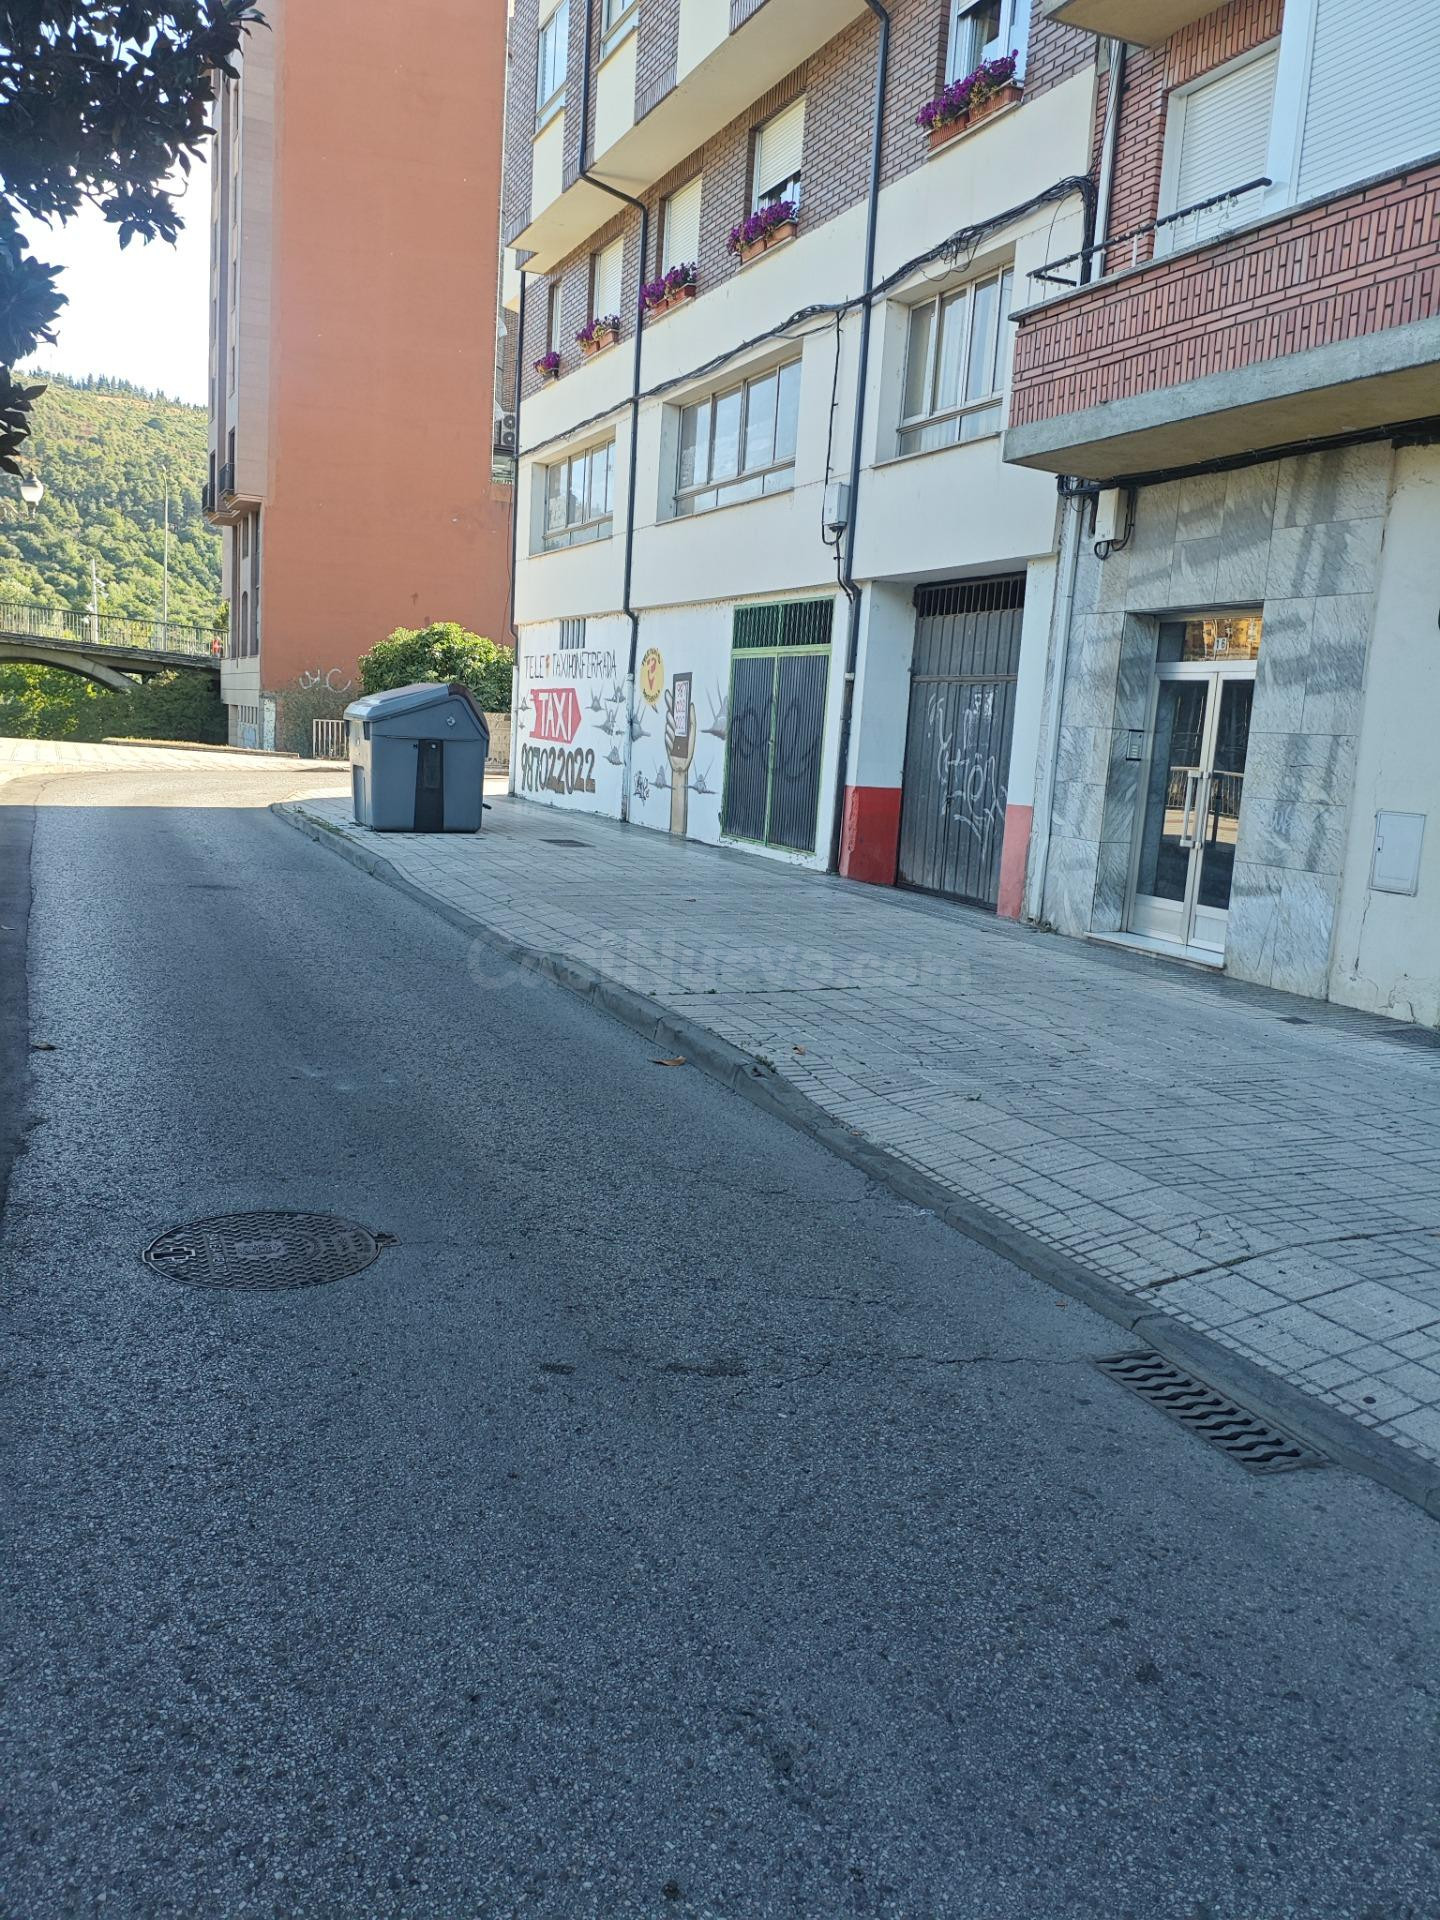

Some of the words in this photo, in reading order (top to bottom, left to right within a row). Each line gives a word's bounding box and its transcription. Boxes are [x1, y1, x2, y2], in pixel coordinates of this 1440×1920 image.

[1216, 638, 1226, 649] 16
[524, 654, 545, 680] TELE
[538, 692, 573, 739] TAXI
[521, 742, 596, 795] 987022022
